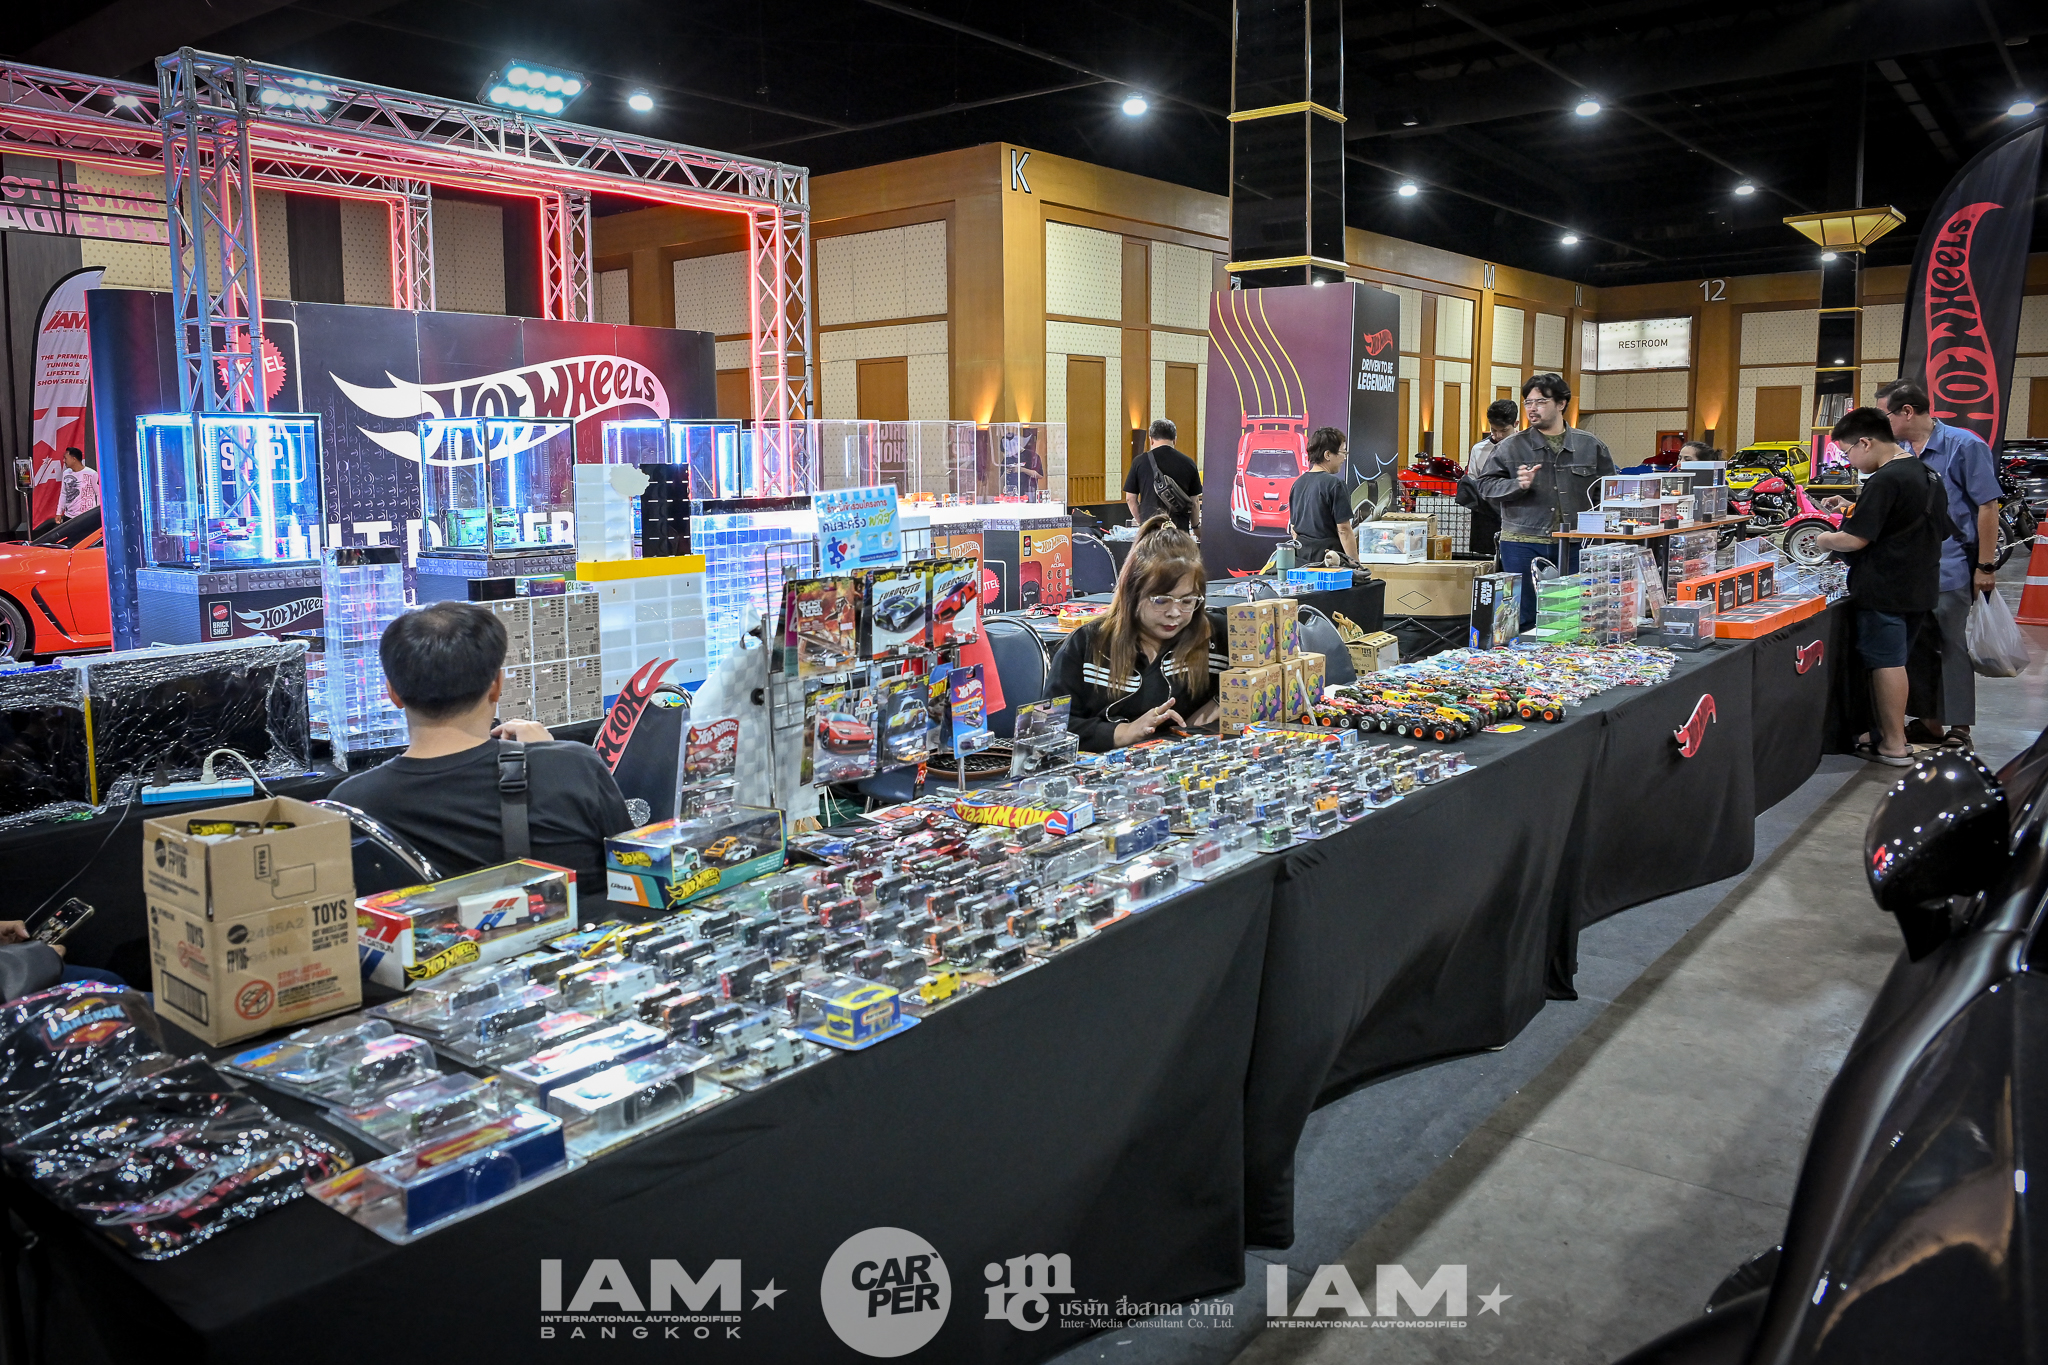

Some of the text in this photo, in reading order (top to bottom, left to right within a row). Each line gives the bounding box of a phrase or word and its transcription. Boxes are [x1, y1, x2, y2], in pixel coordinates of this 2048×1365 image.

[1011, 149, 1032, 194] K
[1483, 263, 1496, 291] M
[1575, 284, 1583, 307] N
[1699, 278, 1727, 302] 12
[1618, 338, 1668, 349] RESTROOM
[1362, 358, 1394, 374] DRIVEN TO BE
[1357, 372, 1396, 392] LEGENDARY
[868, 508, 896, 527] พลัส
[262, 598, 324, 629] HOT WHEEL
[212, 621, 230, 629] BRICK
[694, 729, 713, 745] HOT
[956, 803, 1053, 829] HOT WHEELS
[312, 899, 348, 926] TOYS
[366, 938, 395, 954] DATSUN
